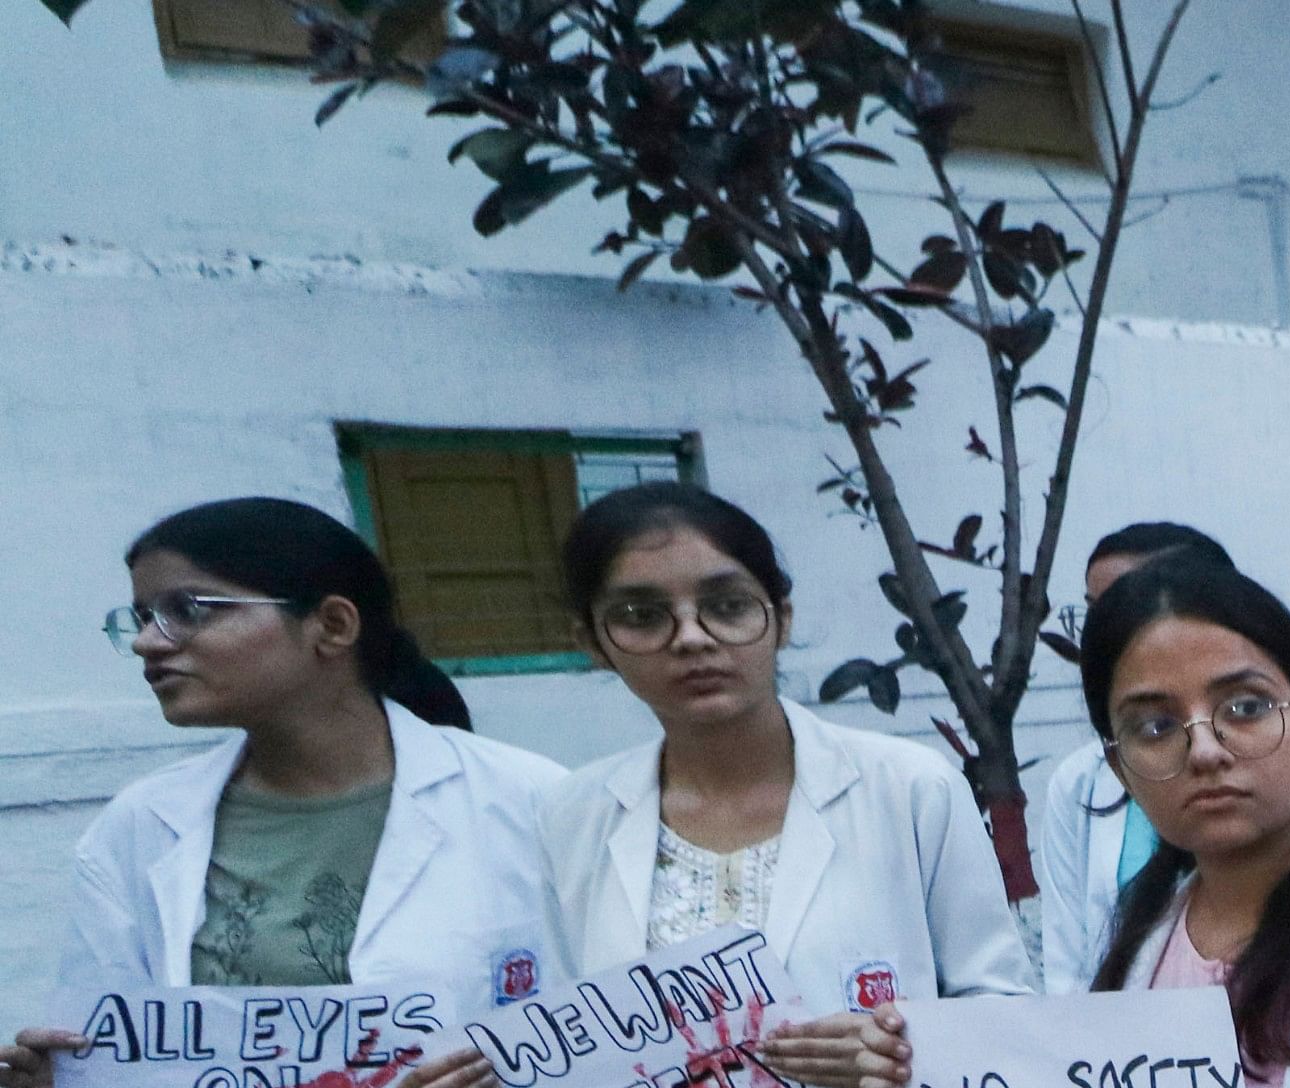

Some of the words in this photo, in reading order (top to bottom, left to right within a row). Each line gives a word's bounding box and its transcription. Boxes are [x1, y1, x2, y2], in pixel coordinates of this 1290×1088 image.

[76, 992, 214, 1062] ALL
[240, 993, 443, 1067] EYES
[465, 1002, 596, 1088] WE
[578, 932, 776, 1055] WANT
